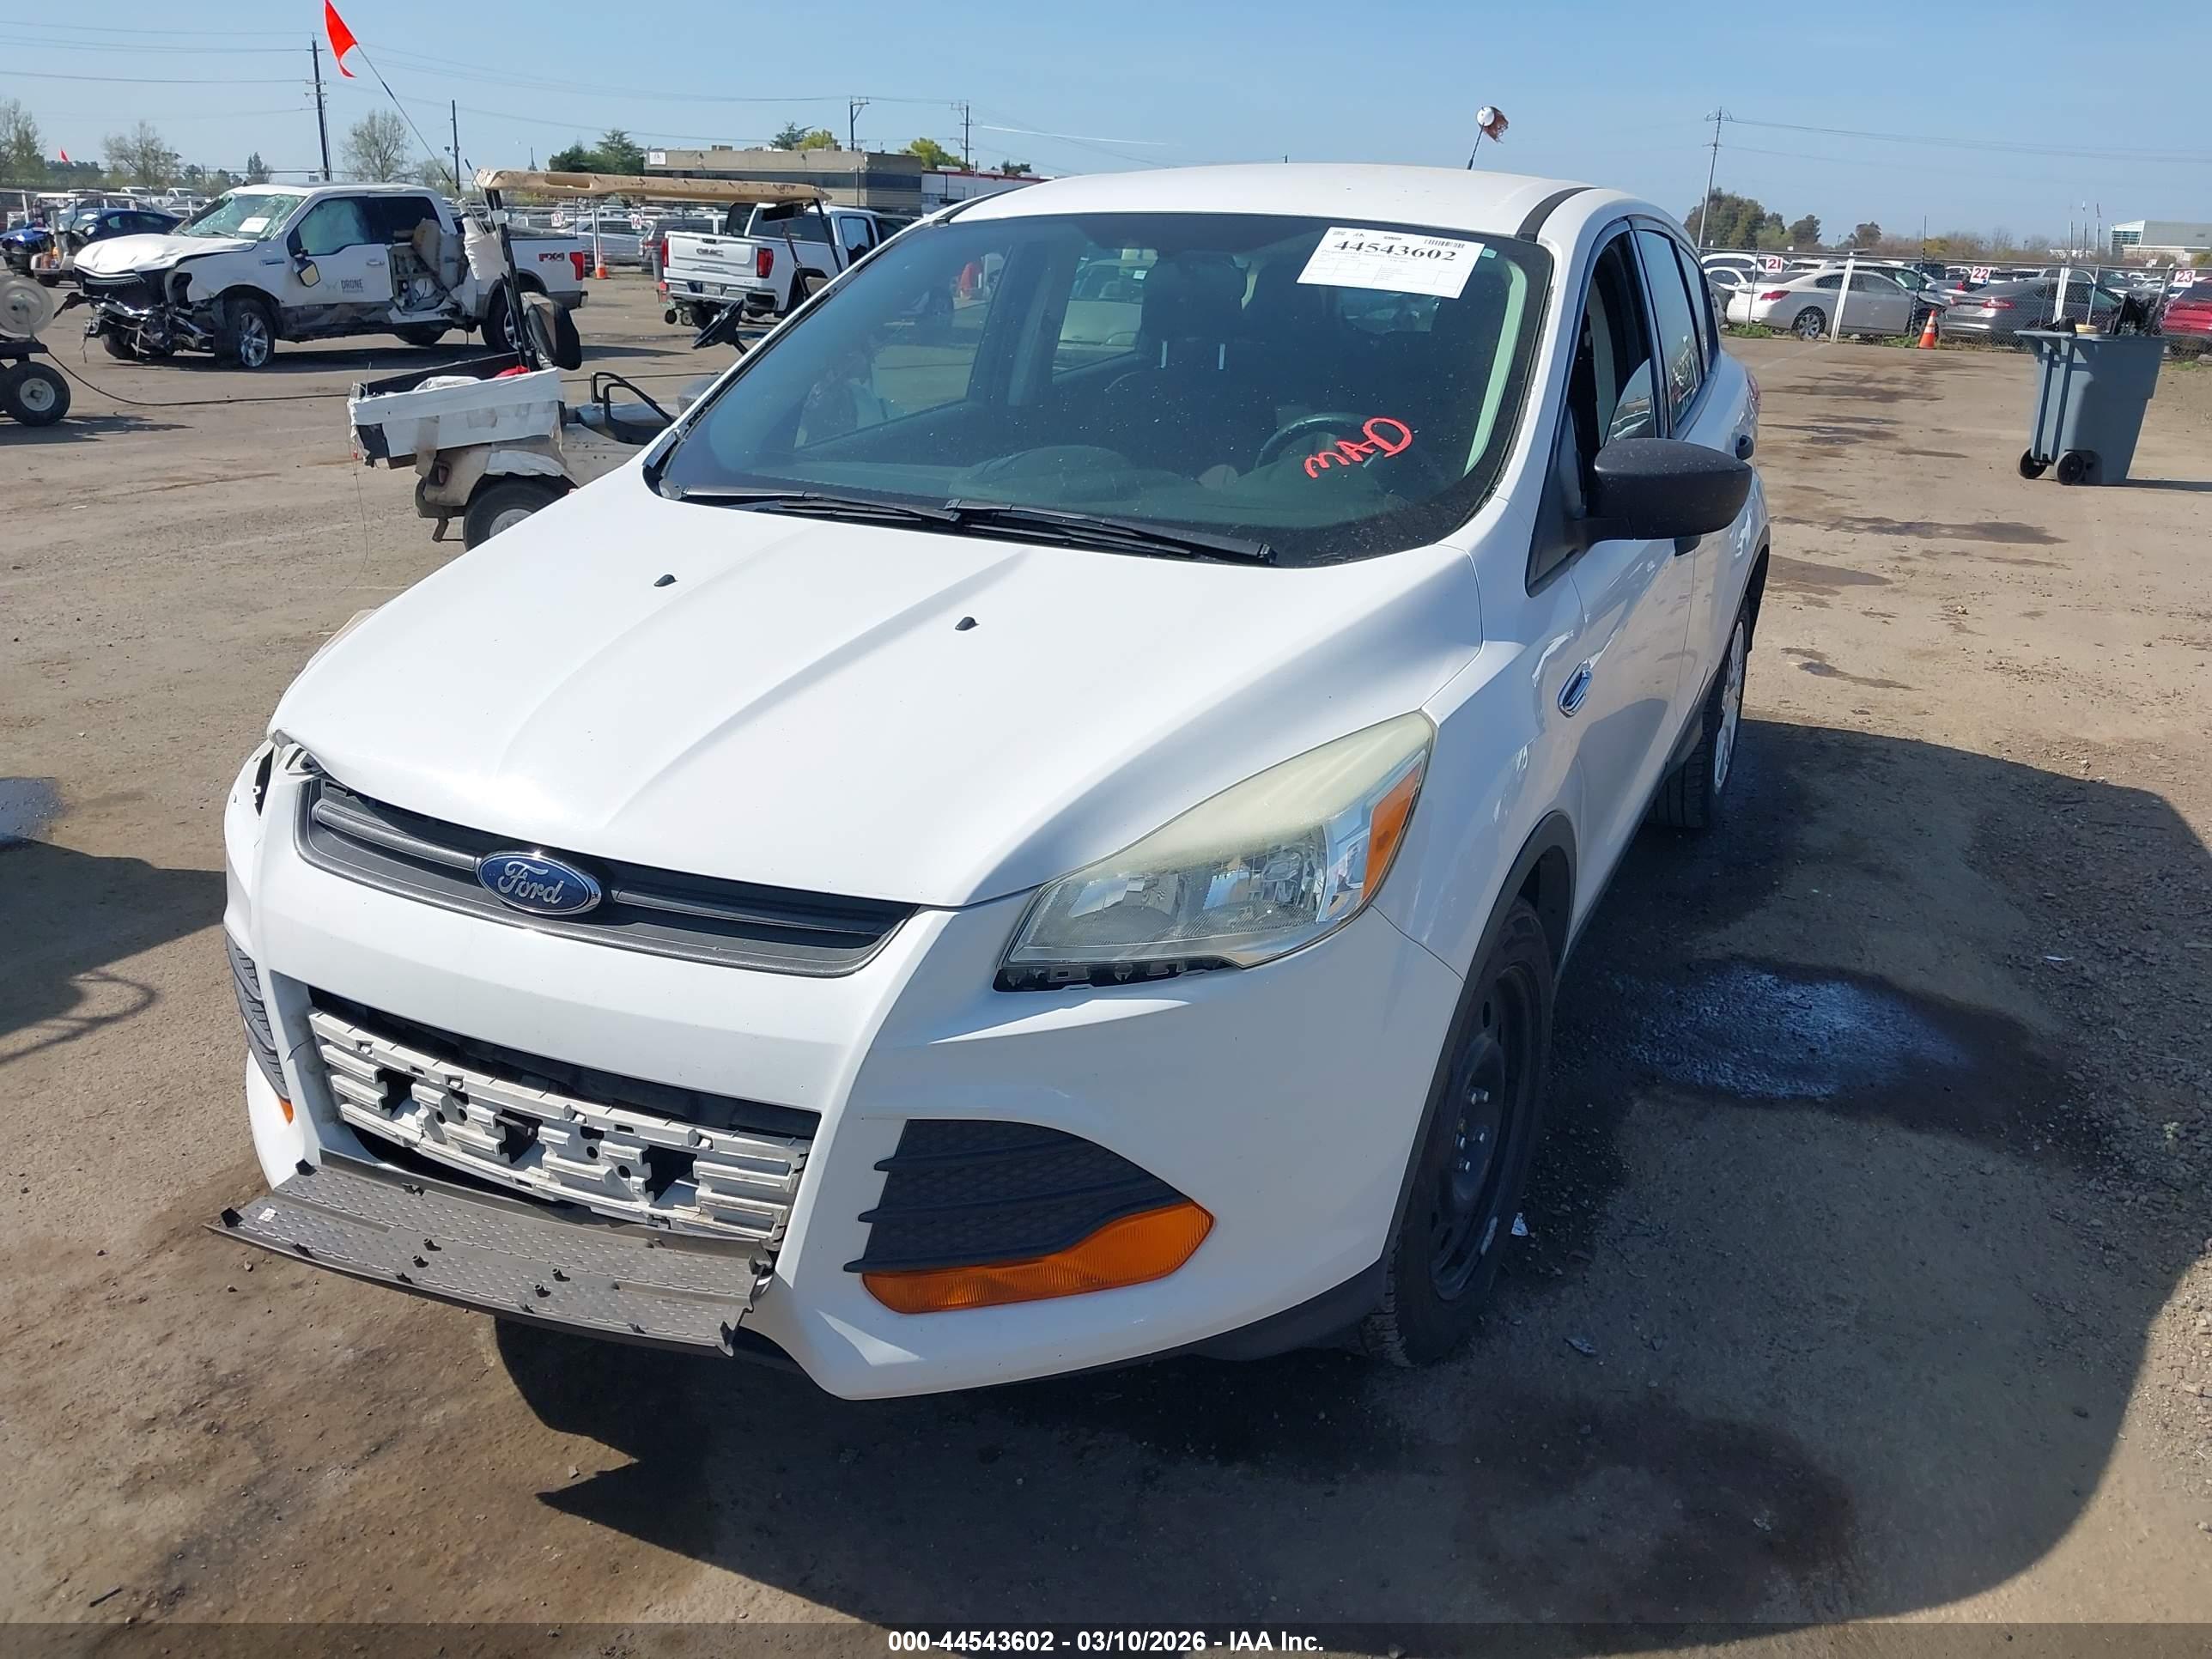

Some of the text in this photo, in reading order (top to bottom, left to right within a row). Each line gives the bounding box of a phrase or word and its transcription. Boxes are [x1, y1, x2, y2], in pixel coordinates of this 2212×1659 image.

[1334, 240, 1457, 261] 44543602
[538, 252, 565, 262] FX4
[1767, 258, 1781, 269] 21
[1972, 267, 1989, 279] 22
[2177, 270, 2193, 283] 23
[340, 278, 364, 289] DRONE
[497, 860, 565, 904] Ford
